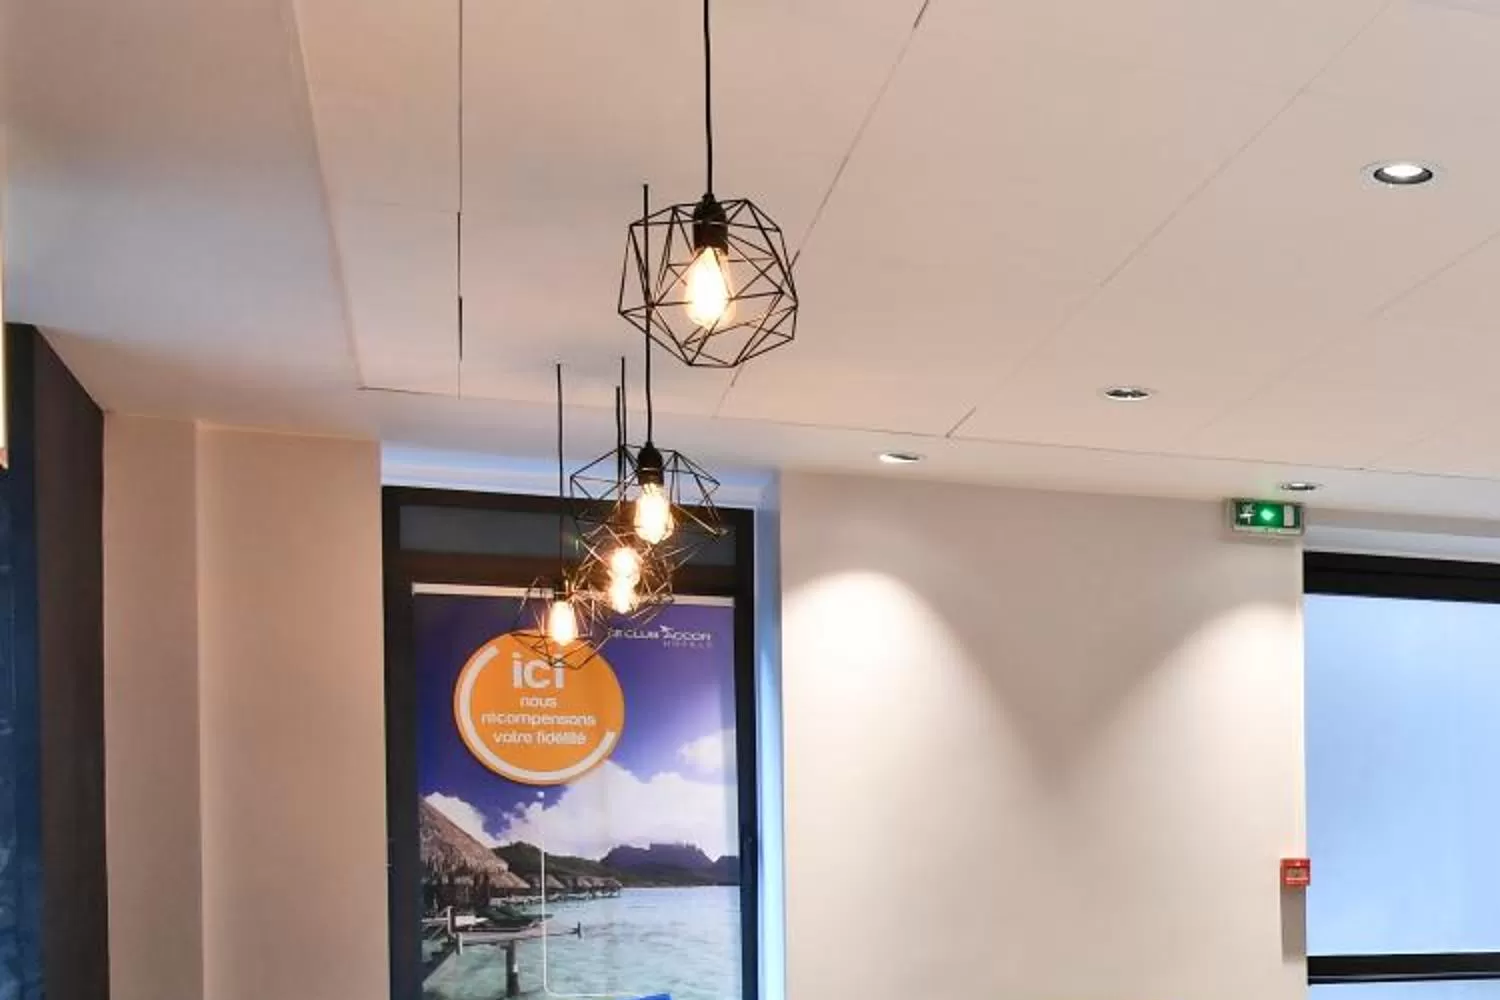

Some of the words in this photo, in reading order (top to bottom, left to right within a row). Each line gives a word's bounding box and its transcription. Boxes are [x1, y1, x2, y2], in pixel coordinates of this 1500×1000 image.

[511, 651, 565, 689] ici
[519, 697, 556, 708] nous
[481, 712, 597, 727] récompensons
[493, 732, 533, 744] votre
